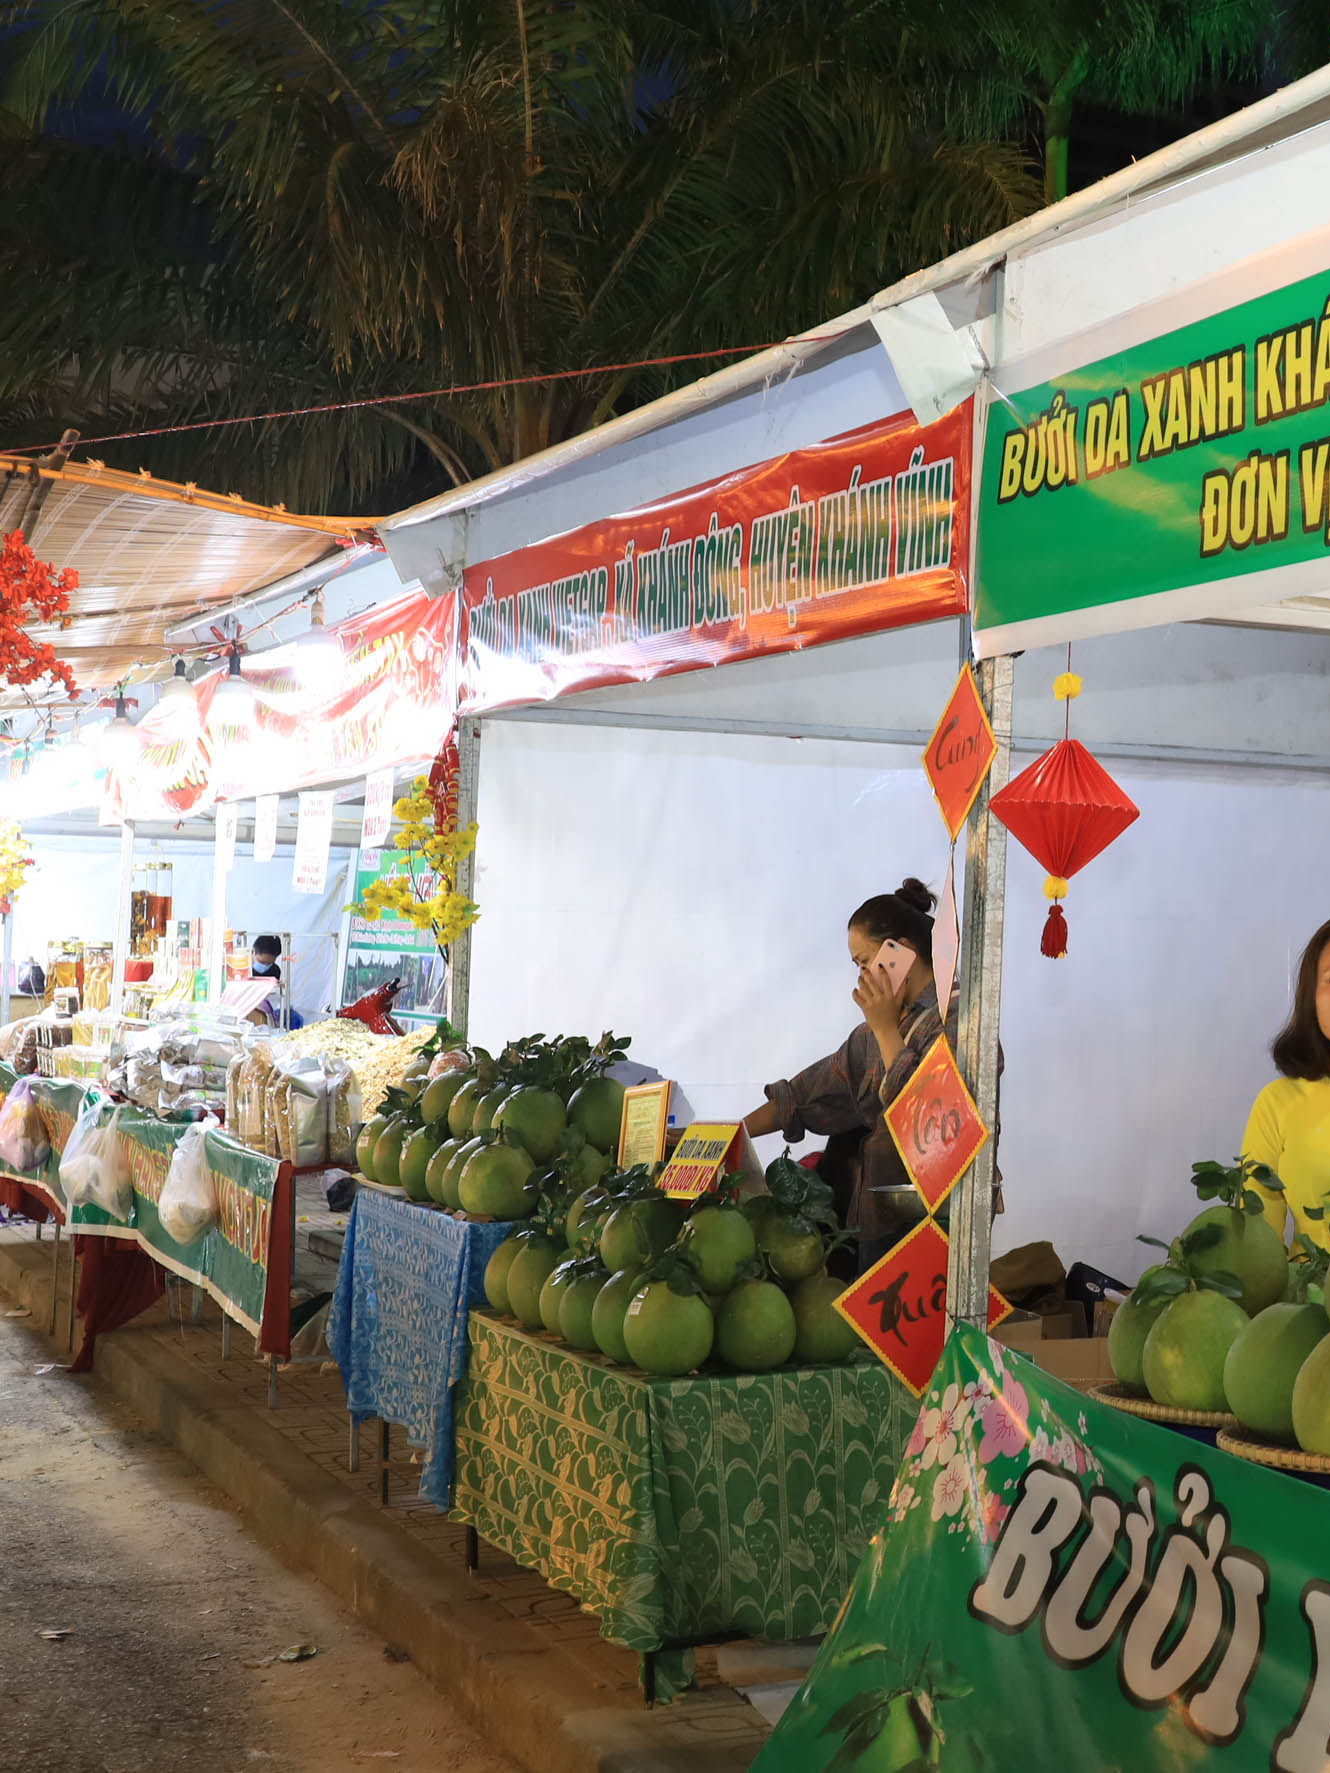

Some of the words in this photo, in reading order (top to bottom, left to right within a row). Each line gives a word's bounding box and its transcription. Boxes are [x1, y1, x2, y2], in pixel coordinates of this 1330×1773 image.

[997, 390, 1079, 503] BƯỞI
[1083, 389, 1131, 480] DA
[1137, 345, 1246, 462] XANH
[1200, 449, 1291, 557] ĐƠN
[636, 529, 693, 637] KHÁNH
[691, 512, 747, 631] ĐÔNG,
[749, 484, 816, 628] HUYỆN
[815, 464, 893, 600] KHÁNH
[894, 444, 954, 580] VĨNH
[968, 1459, 1271, 1747] BƯỞI
